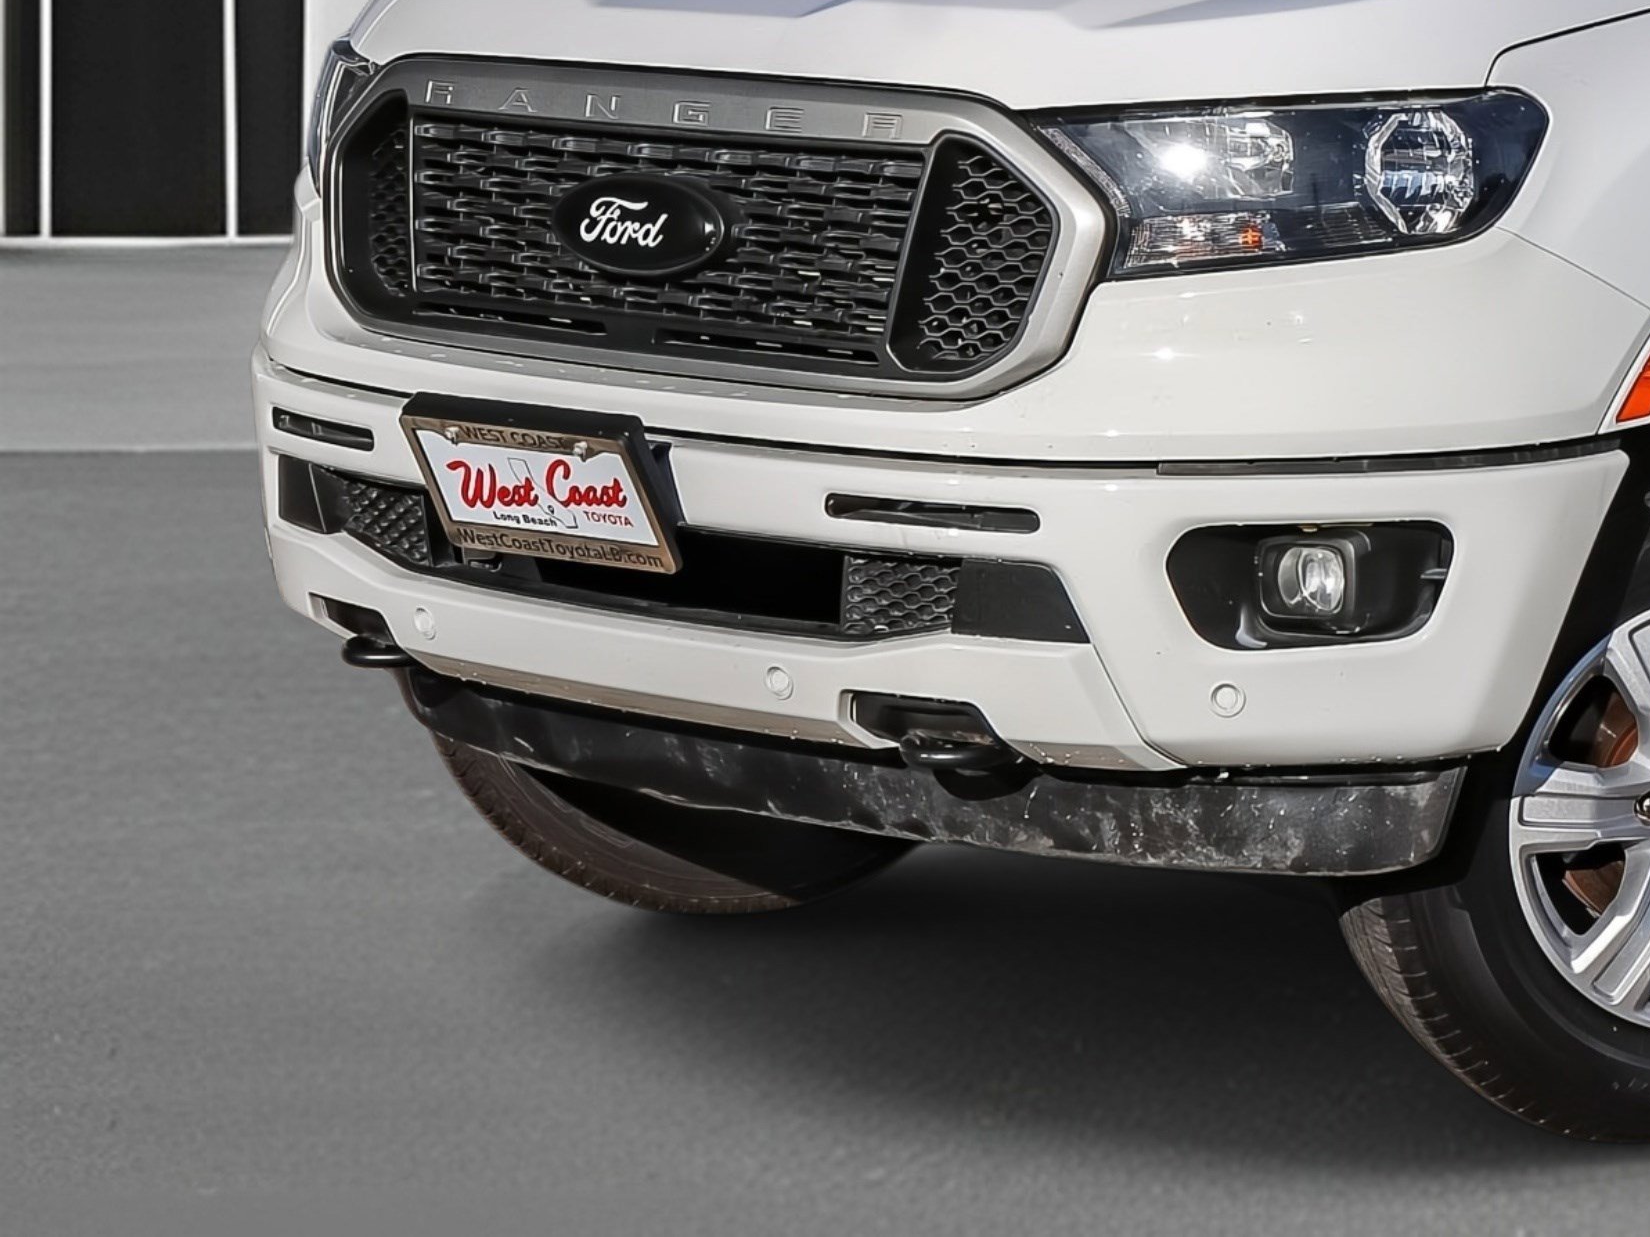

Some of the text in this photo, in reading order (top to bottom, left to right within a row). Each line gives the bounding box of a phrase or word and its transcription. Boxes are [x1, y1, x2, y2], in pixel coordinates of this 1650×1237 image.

[424, 79, 904, 139] RANGER
[579, 196, 669, 248] Ford
[461, 425, 567, 450] WEST COAST
[445, 459, 628, 509] West Coast
[493, 511, 558, 528] Long Beach
[582, 510, 635, 528] TOYOTA
